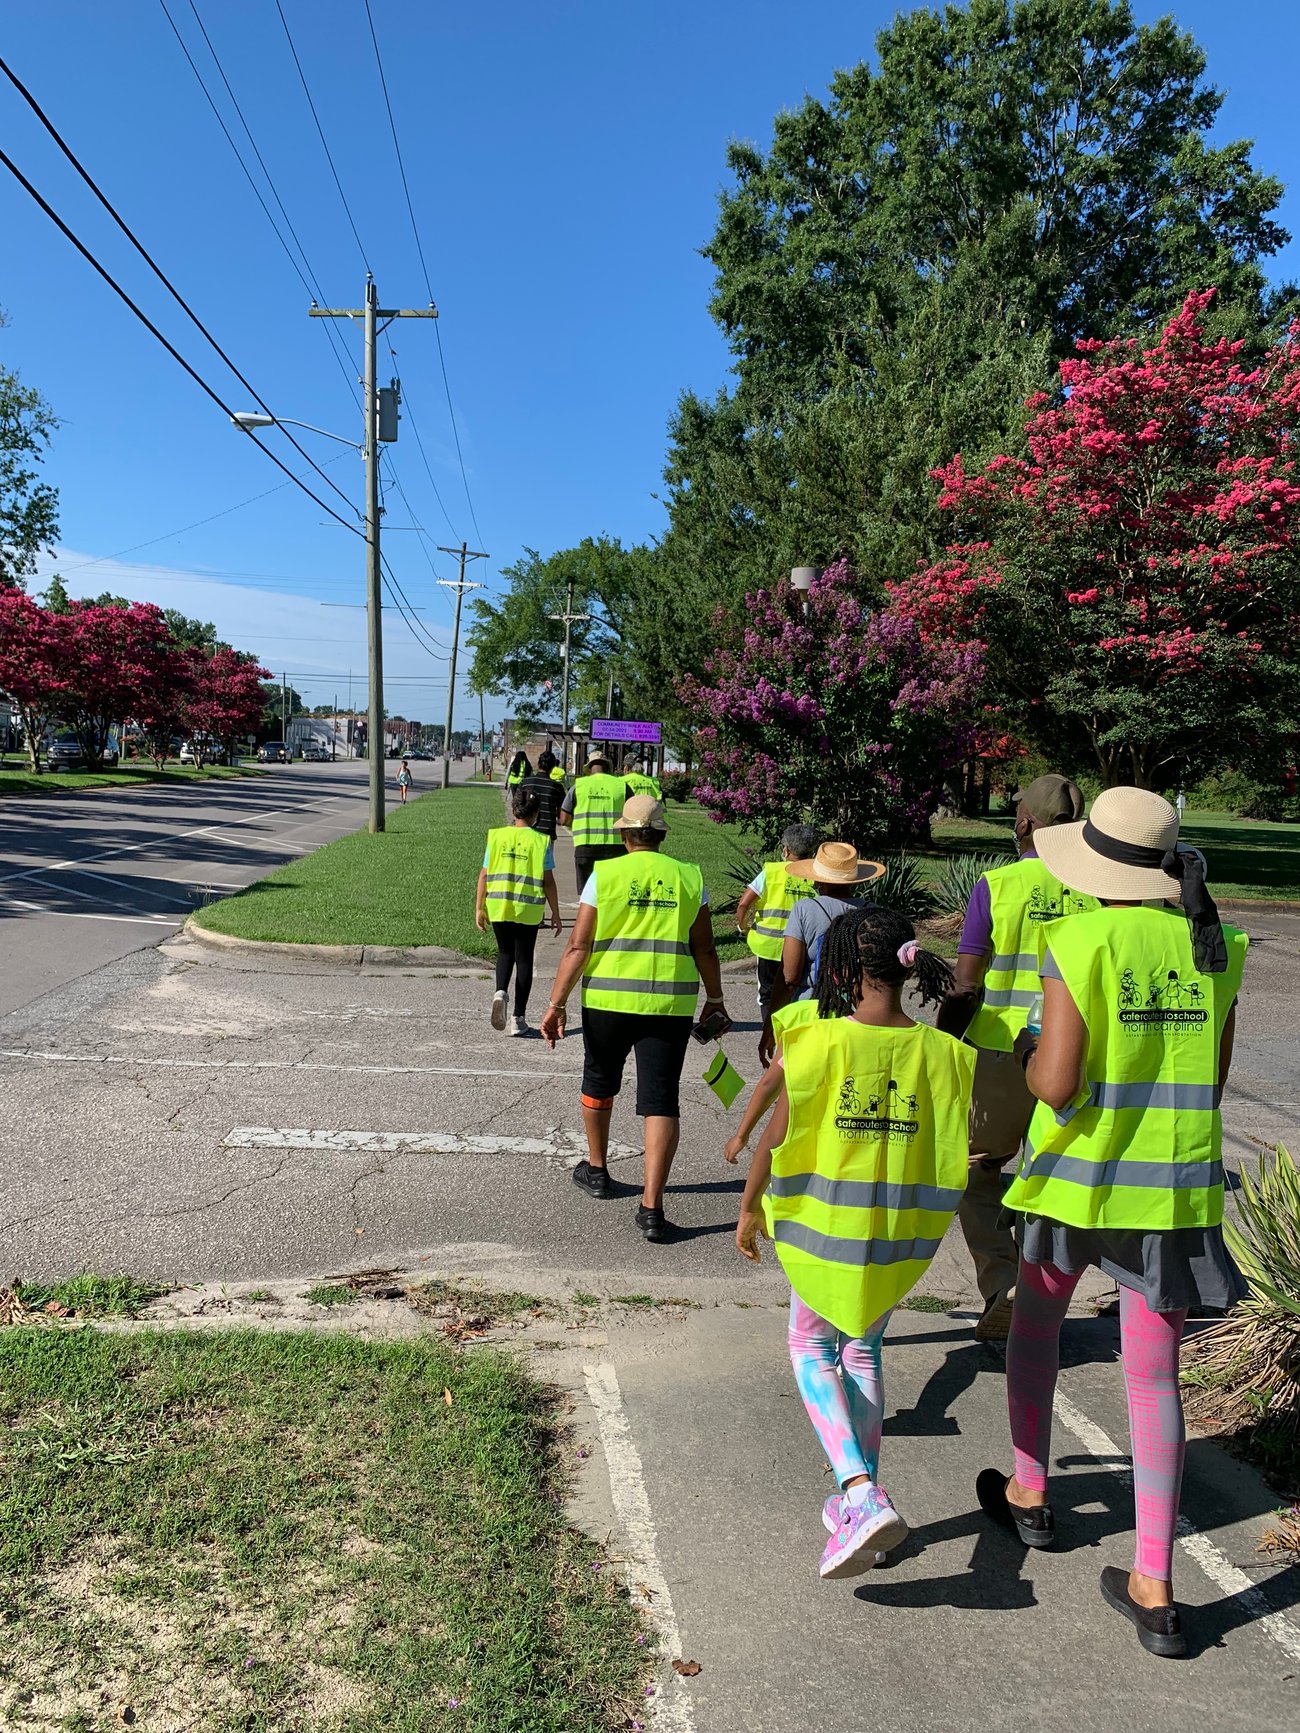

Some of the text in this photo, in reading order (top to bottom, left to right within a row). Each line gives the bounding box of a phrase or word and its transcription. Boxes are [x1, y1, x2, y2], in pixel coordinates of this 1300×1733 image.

[1123, 1021, 1204, 1032] north carolina
[838, 1129, 869, 1140] north
